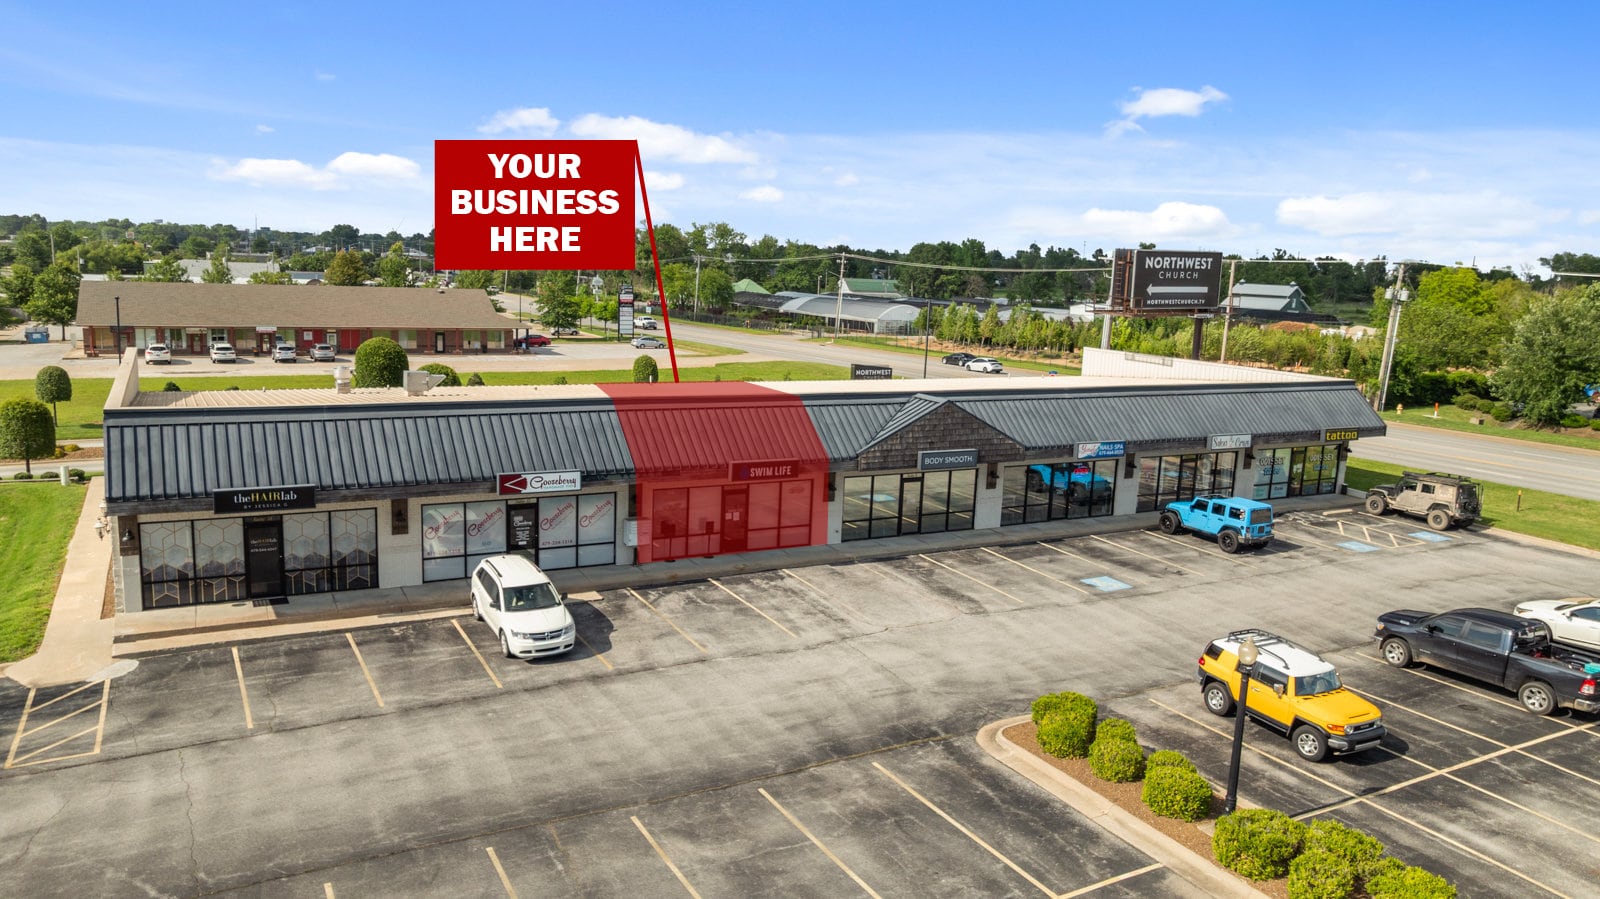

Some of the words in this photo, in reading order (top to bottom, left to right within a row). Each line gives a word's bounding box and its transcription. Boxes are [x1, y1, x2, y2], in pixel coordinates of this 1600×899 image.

[1145, 256, 1213, 269] NORTHWEST
[1158, 271, 1199, 279] CHURCH
[1326, 430, 1358, 441] tattoo
[924, 457, 944, 465] BODY
[945, 455, 973, 464] SMOOTH
[750, 467, 773, 477] SWIM
[774, 466, 792, 475] LIFE
[529, 475, 577, 489] Gooseberry
[234, 491, 297, 503] theHAIRlab
